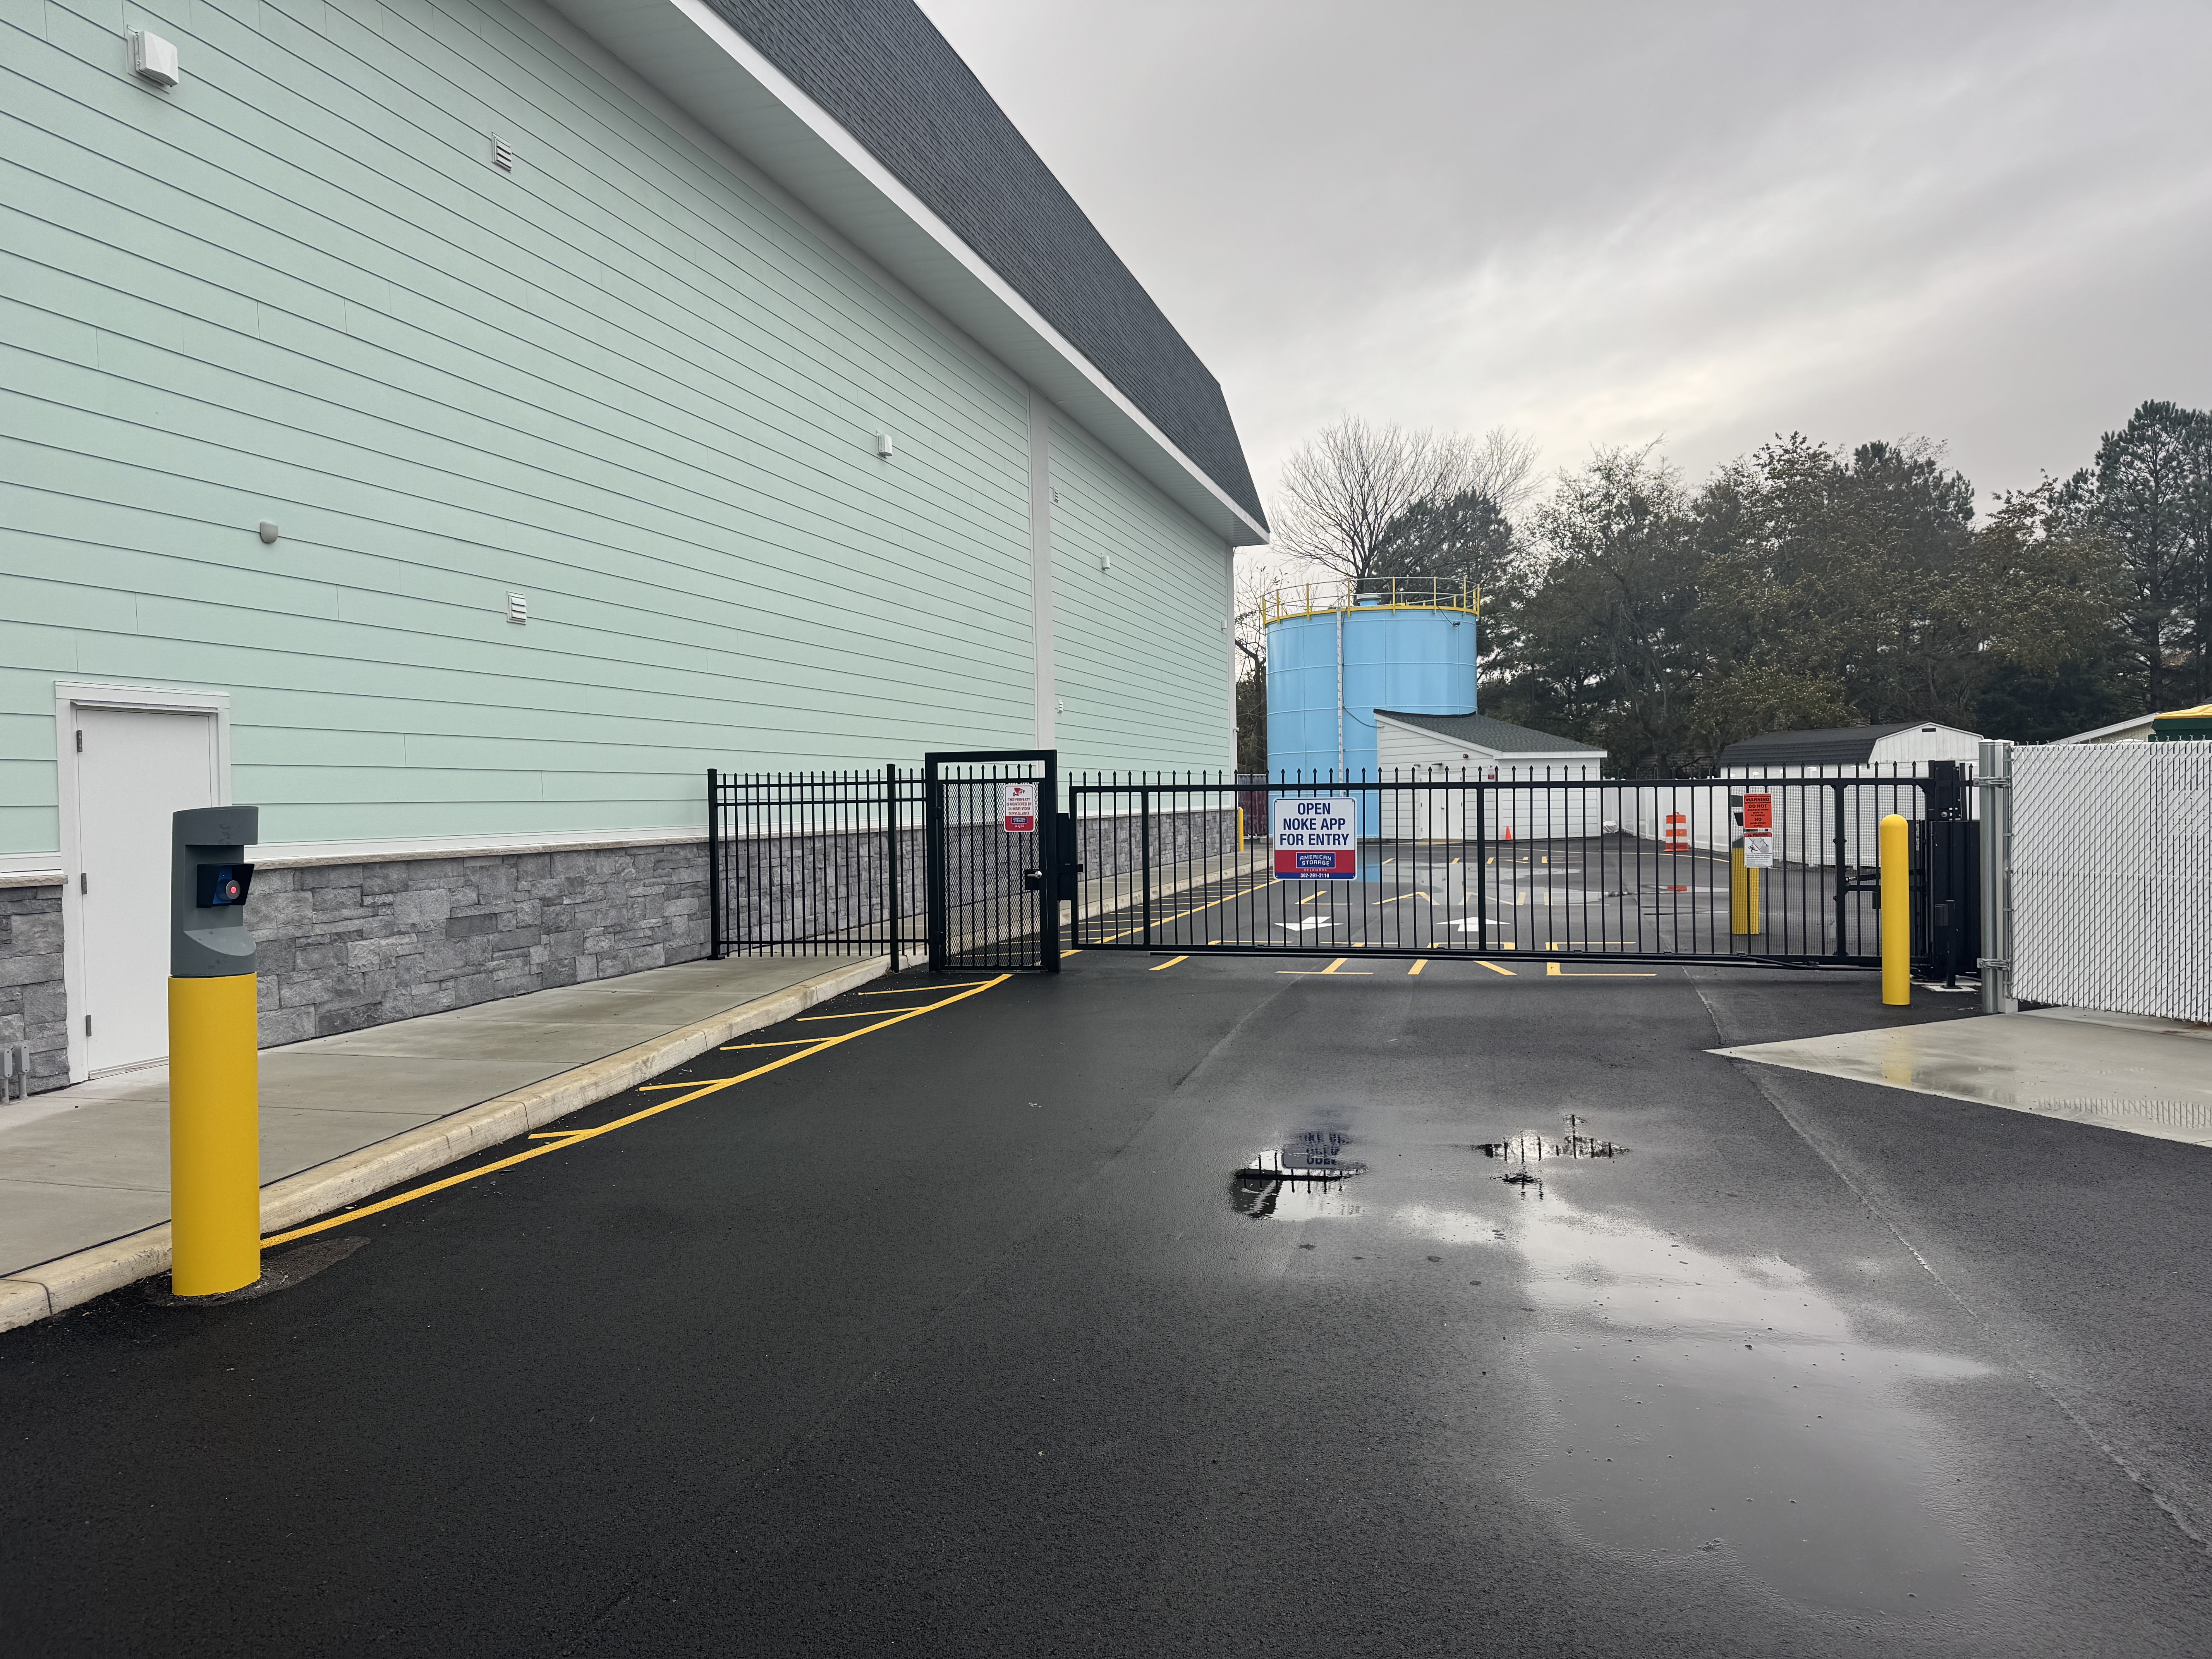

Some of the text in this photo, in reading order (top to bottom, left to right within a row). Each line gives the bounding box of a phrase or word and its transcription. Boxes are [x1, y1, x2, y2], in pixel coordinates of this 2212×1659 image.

[1298, 803, 1331, 815] OPEN
[1283, 818, 1346, 830] NOKE APP
[1280, 833, 1349, 845] FOR ENTRY
